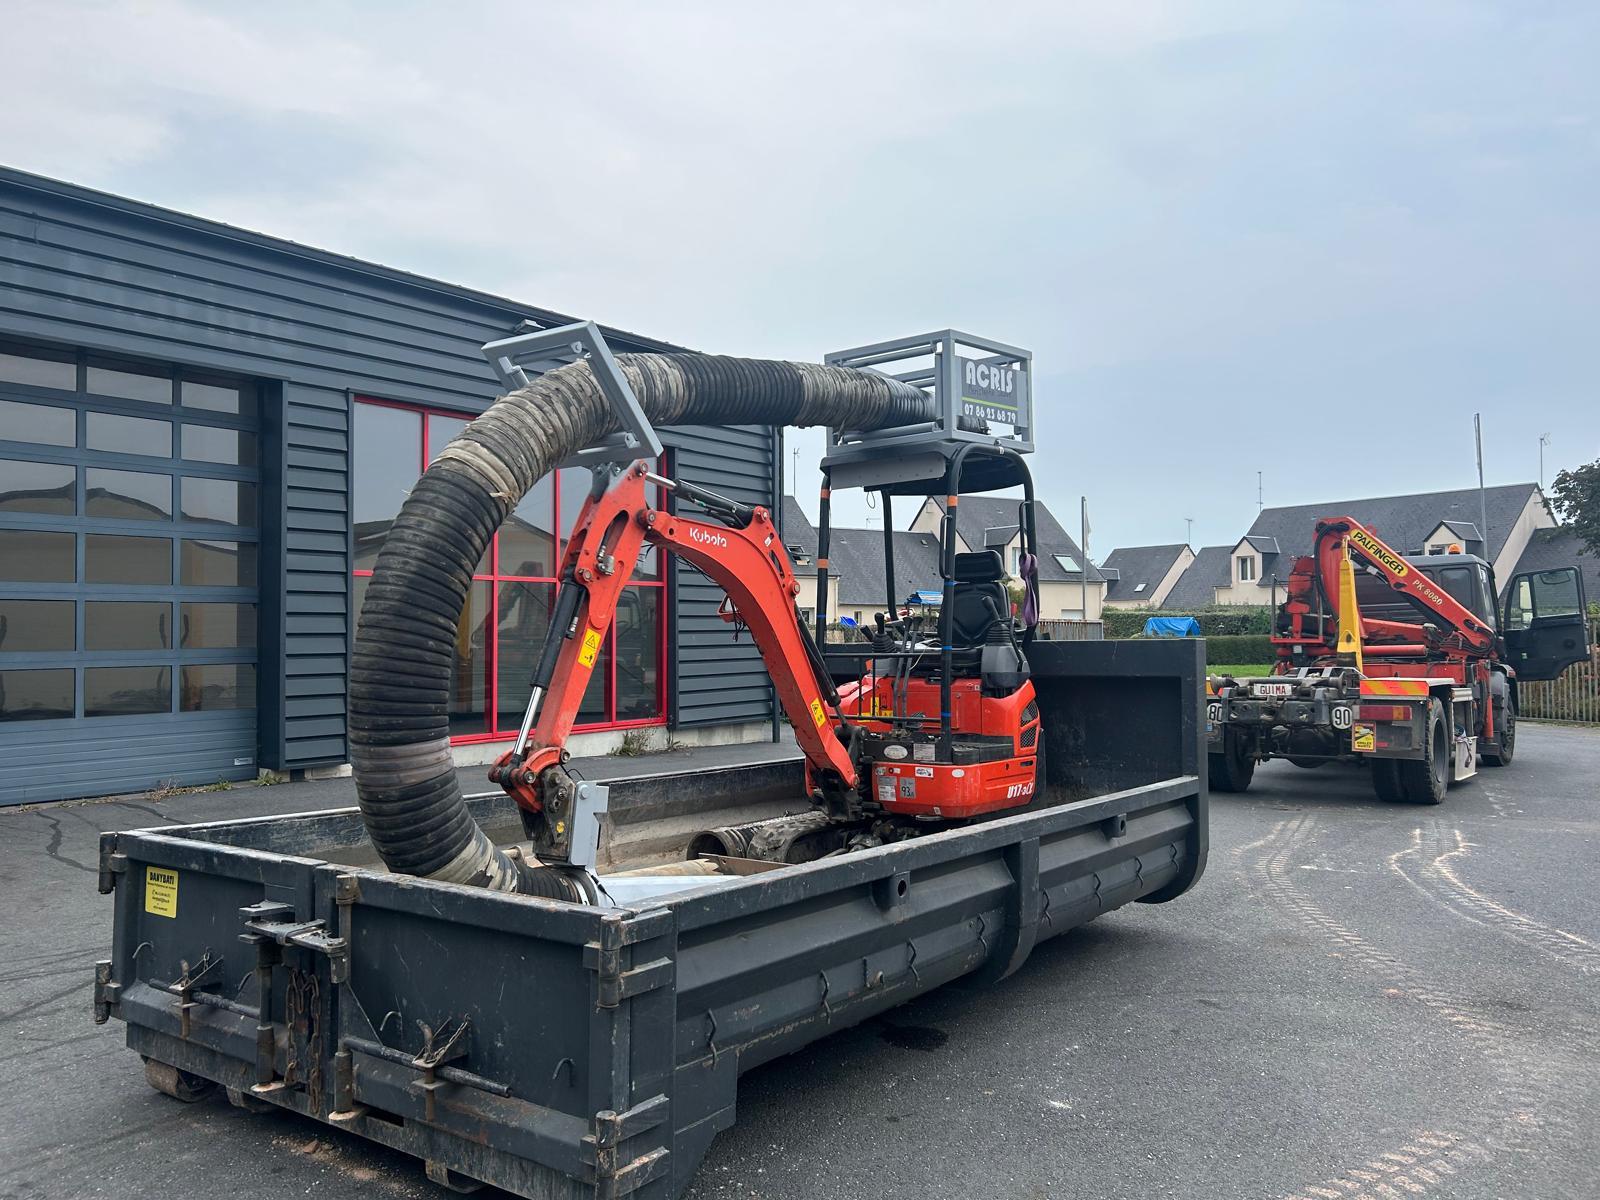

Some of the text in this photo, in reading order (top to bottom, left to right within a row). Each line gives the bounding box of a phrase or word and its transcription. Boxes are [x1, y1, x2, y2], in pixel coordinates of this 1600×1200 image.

[965, 361, 1013, 393] ACRIS
[964, 403, 1016, 423] 07 86 23 68 79
[689, 527, 727, 547] Kubota
[1353, 531, 1404, 574] PALFINGER
[1412, 579, 1424, 591] PK
[1260, 685, 1286, 695] GUIMA
[1335, 709, 1350, 726] 90
[901, 786, 911, 797] 93
